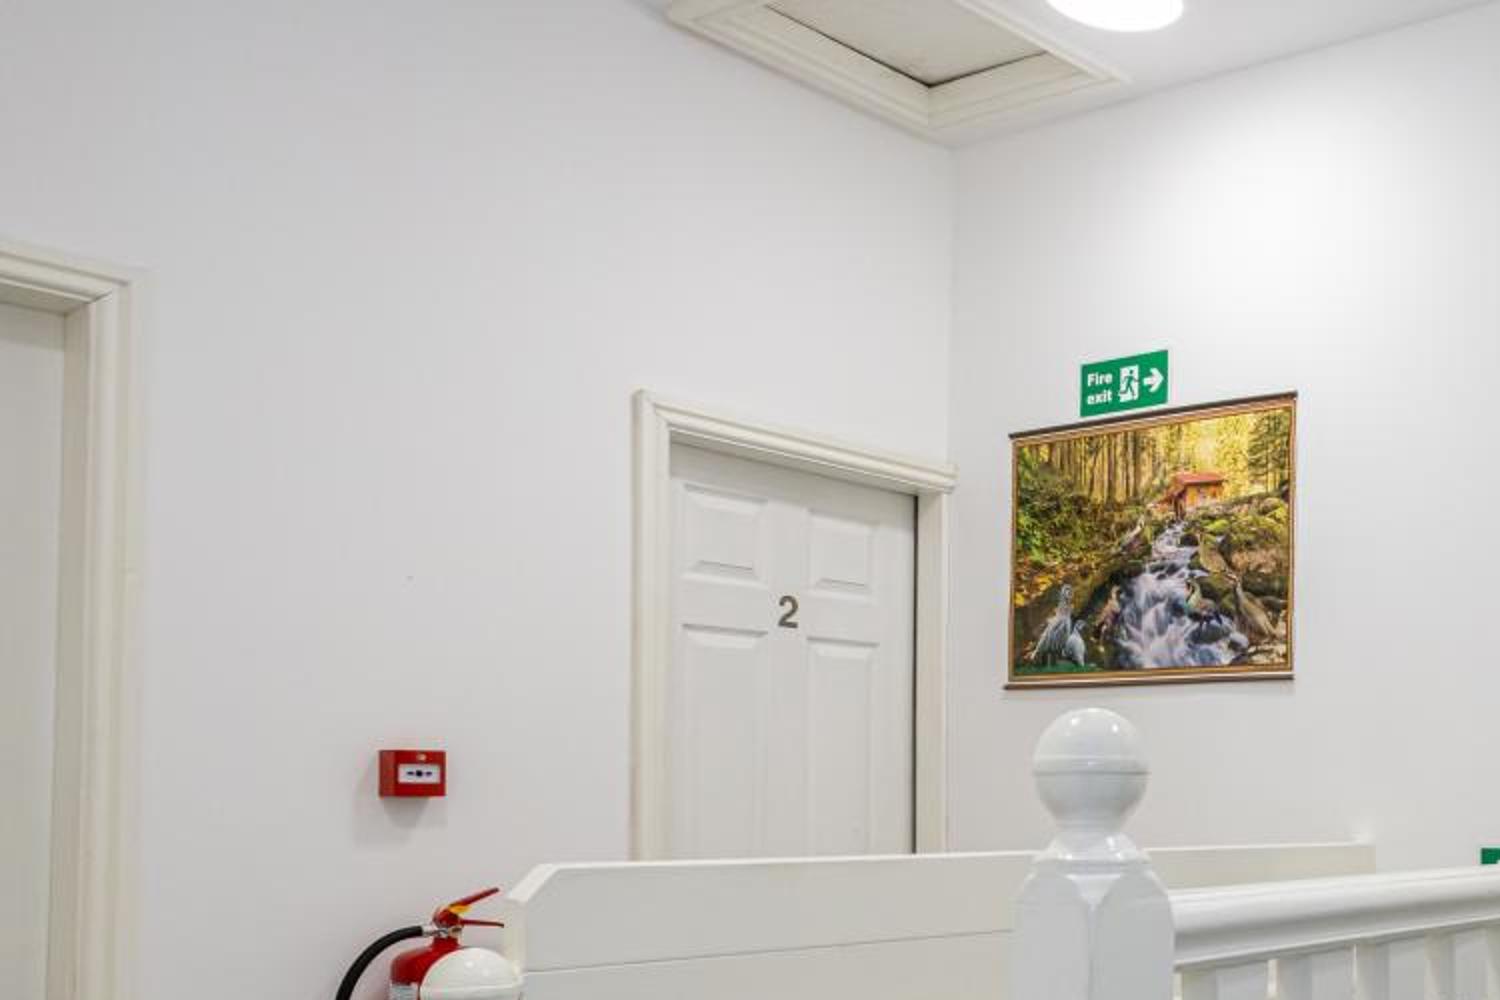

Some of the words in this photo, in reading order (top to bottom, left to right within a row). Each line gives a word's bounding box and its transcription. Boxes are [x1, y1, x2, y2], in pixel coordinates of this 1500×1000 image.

[1087, 372, 1113, 387] Fire
[1087, 389, 1112, 405] exit
[778, 595, 799, 628] 2
